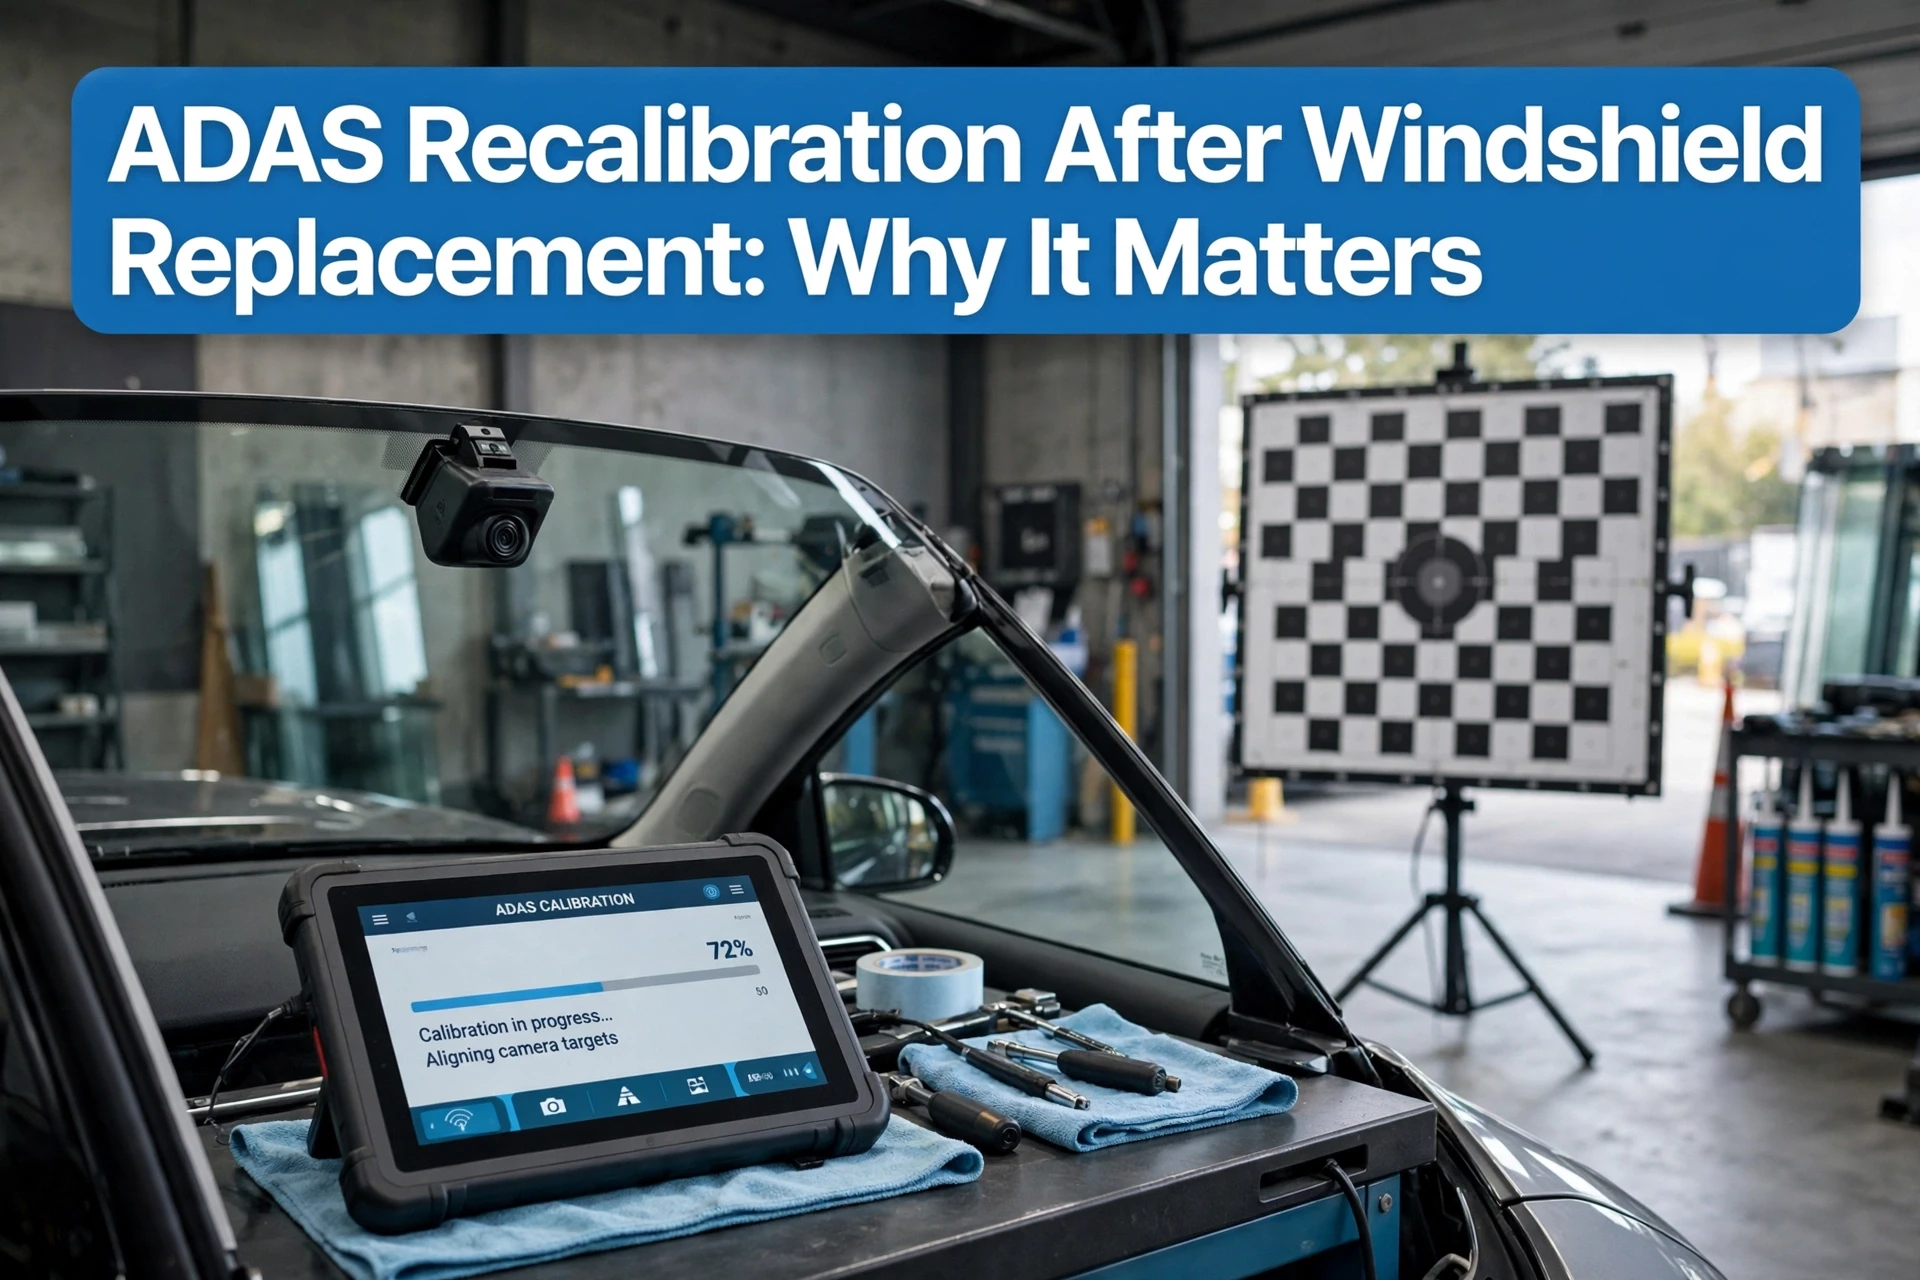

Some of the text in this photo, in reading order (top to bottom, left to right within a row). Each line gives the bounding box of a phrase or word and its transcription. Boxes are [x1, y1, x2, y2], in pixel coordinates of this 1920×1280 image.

[496, 892, 635, 917] ADAS CALIBRATION
[706, 939, 753, 960] 72%
[755, 986, 769, 996] 50
[418, 1010, 613, 1043] Calibration in progress...
[426, 1031, 619, 1069] Aligning camera targets
